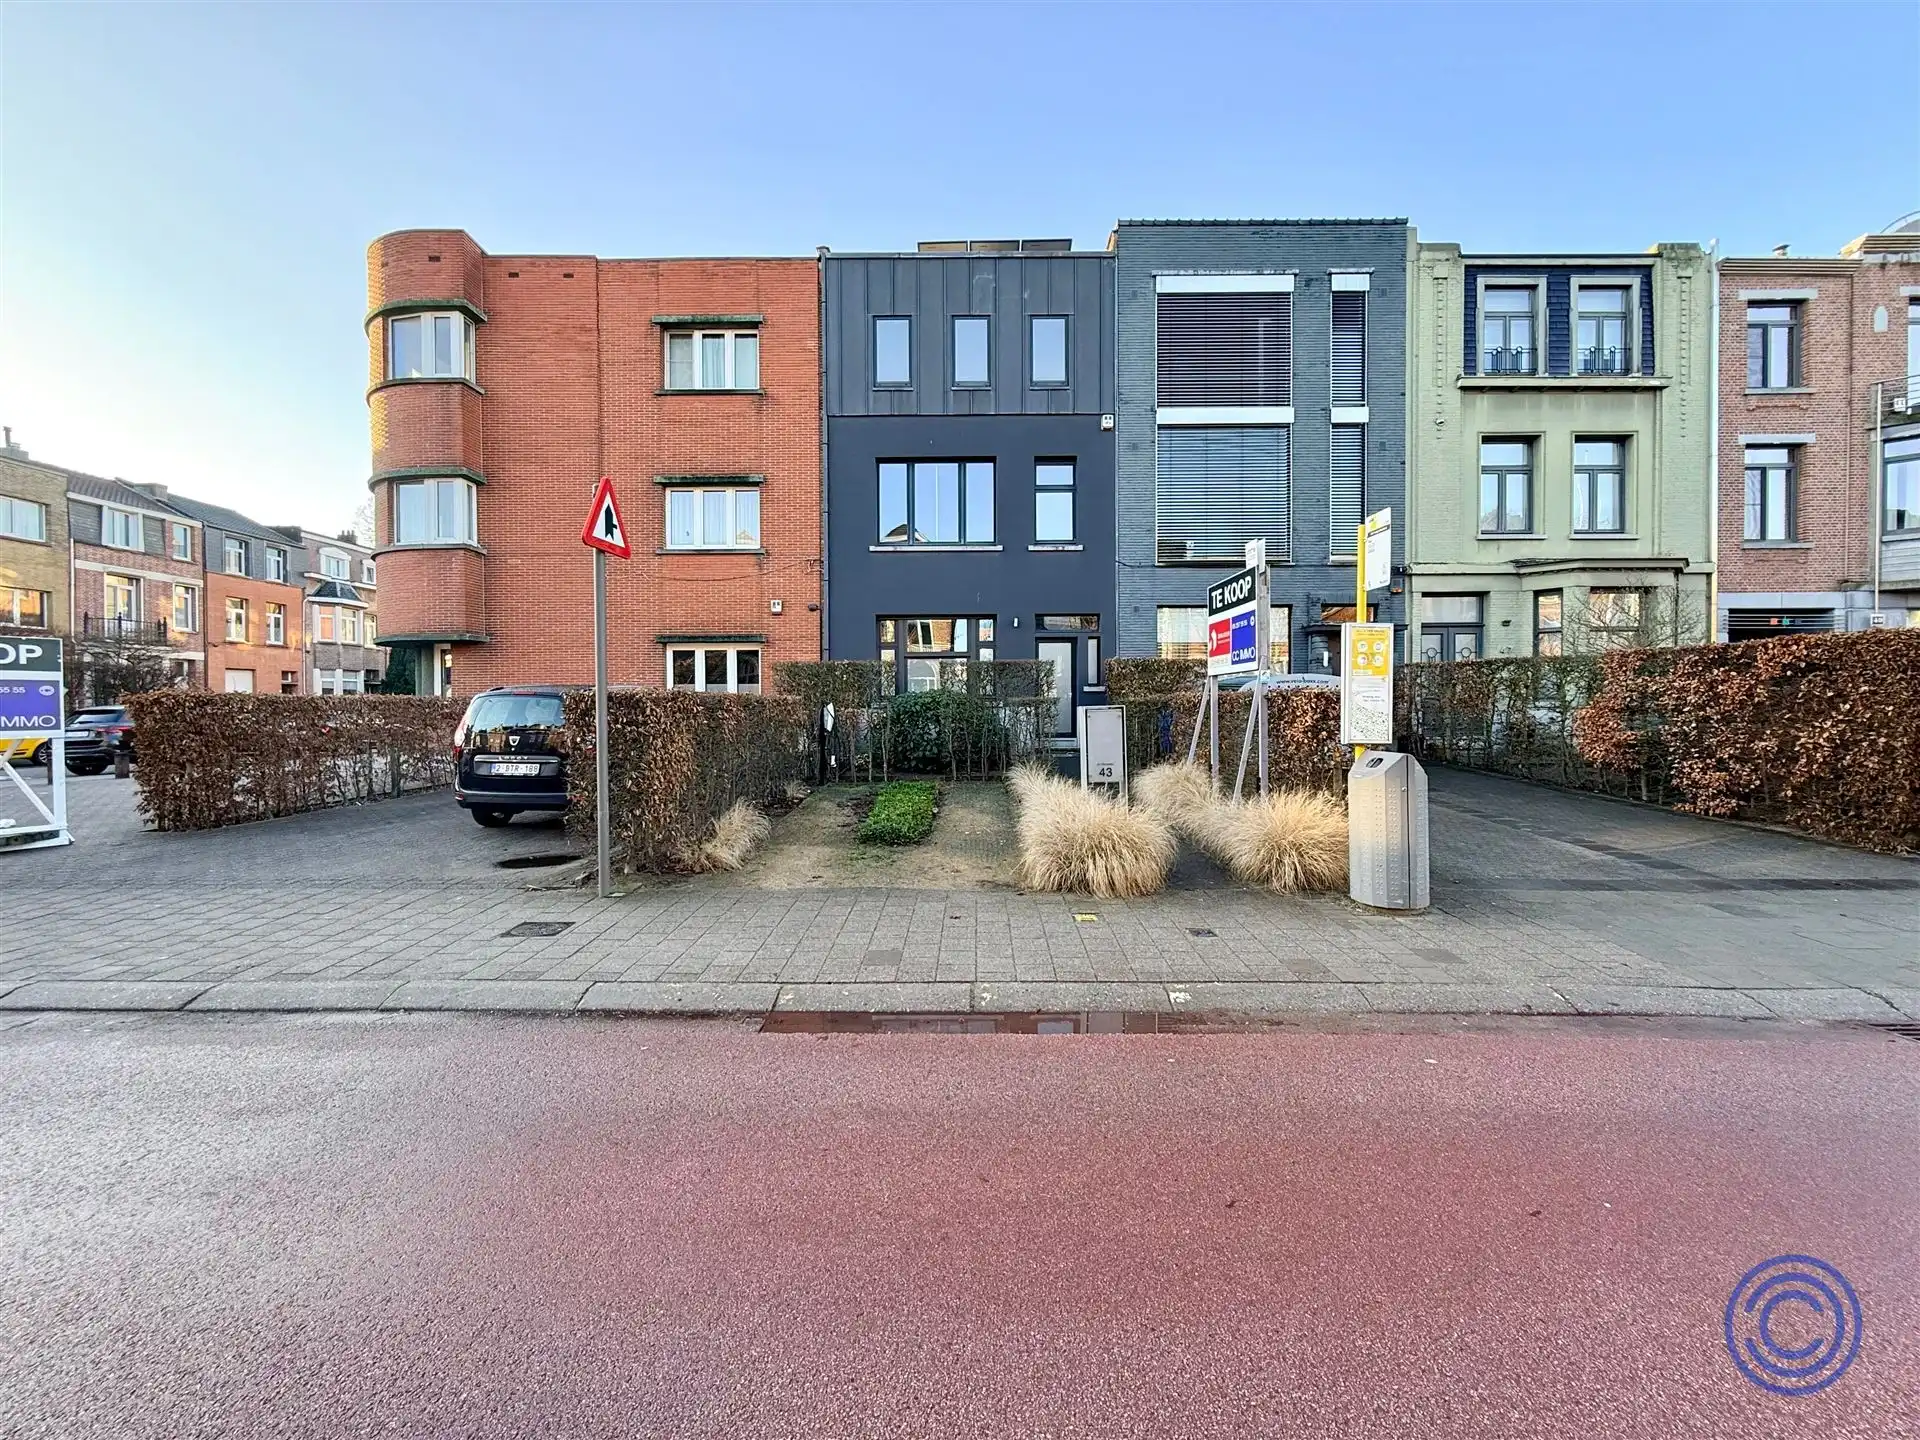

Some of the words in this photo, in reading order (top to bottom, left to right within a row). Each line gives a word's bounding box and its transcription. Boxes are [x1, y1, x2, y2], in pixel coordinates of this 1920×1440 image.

[1211, 588, 1223, 610] TE
[1224, 575, 1252, 605] KOOP
[1099, 767, 1113, 777] 43
